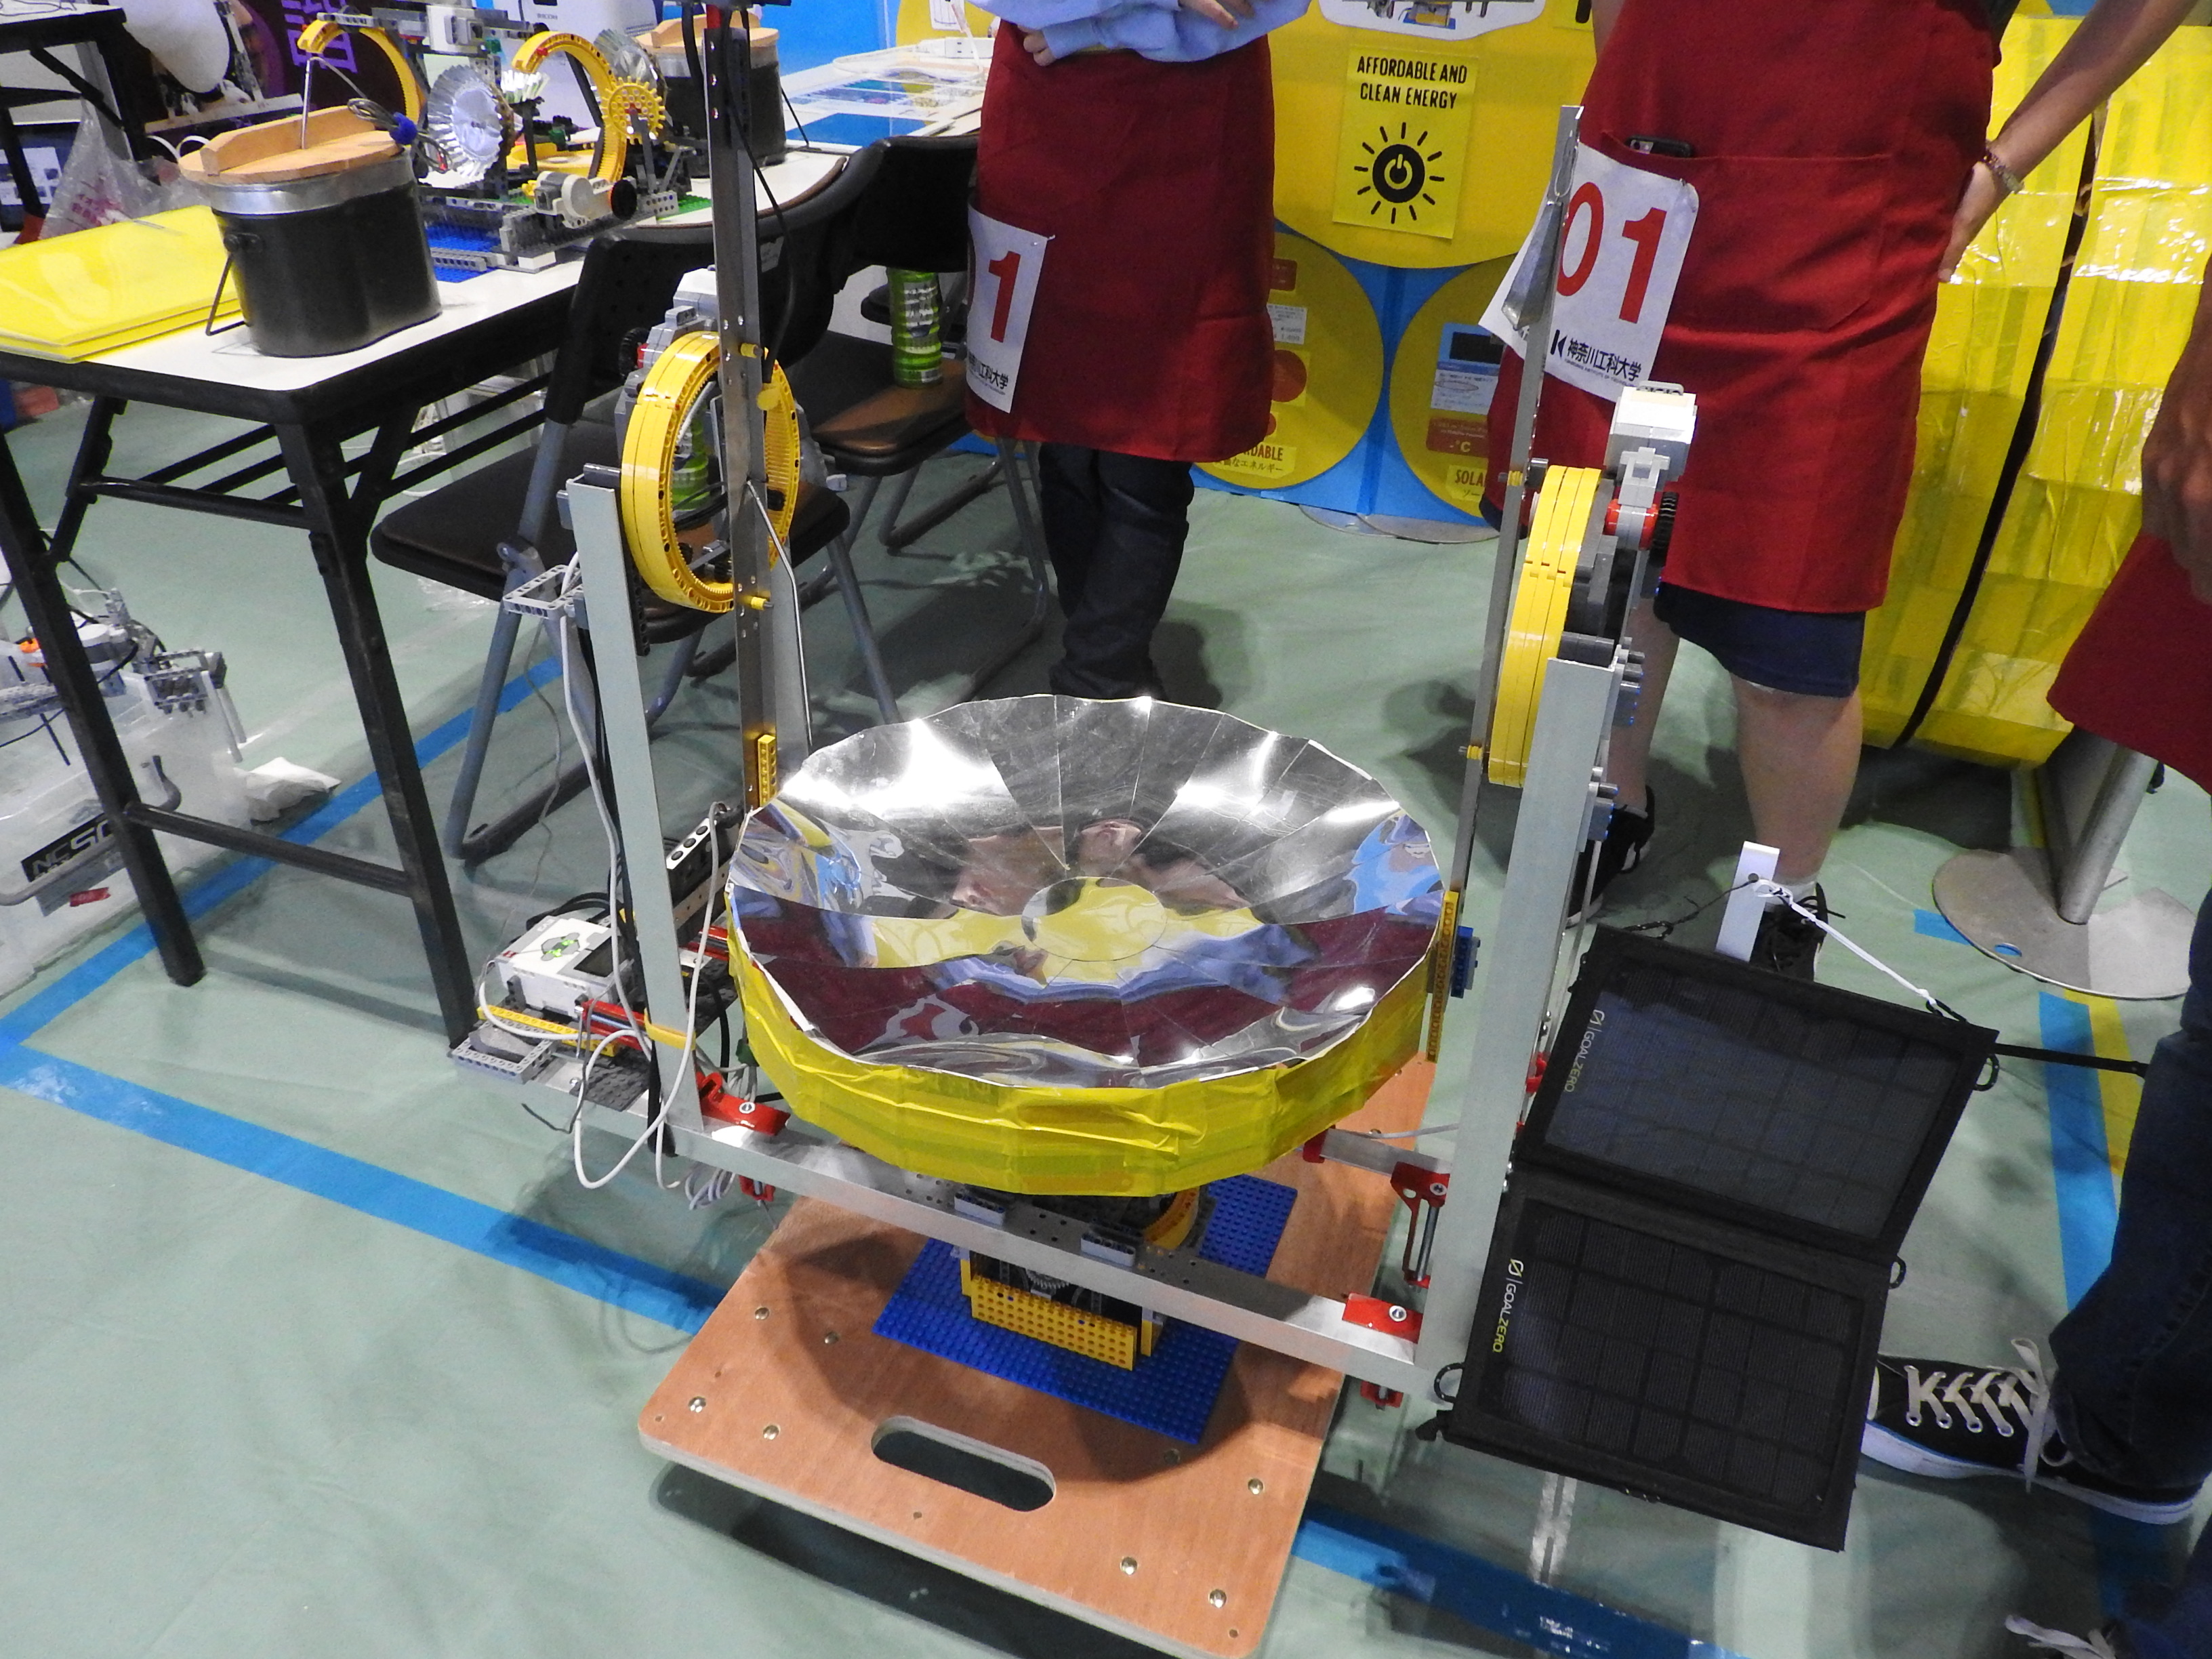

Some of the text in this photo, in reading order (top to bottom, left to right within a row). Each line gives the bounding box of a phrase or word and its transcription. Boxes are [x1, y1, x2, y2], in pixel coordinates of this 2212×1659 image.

[1357, 56, 1468, 84] AFFORDABLE AND
[1360, 83, 1458, 110] CLEAN ENERGY
[1556, 181, 1668, 324] 01
[988, 251, 1021, 343] 1
[1568, 337, 1642, 382] 神奈川工科大学
[1454, 470, 1484, 487] SOLA
